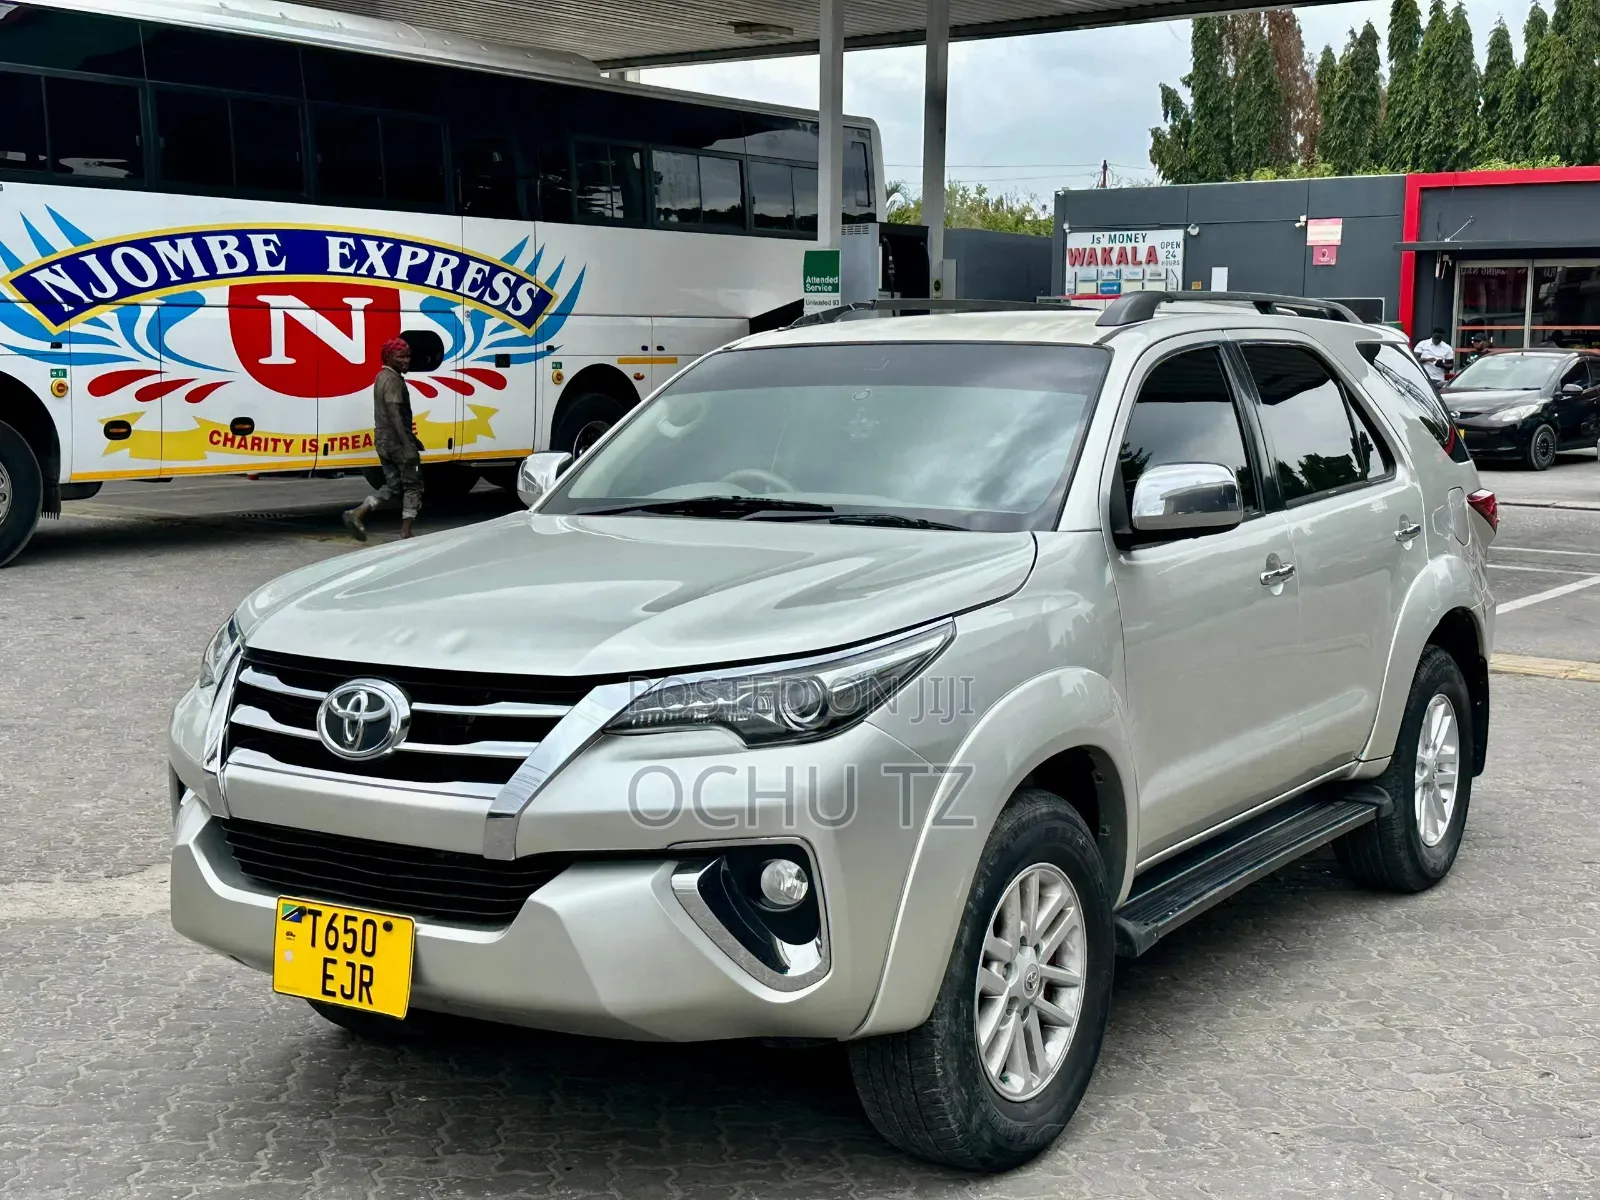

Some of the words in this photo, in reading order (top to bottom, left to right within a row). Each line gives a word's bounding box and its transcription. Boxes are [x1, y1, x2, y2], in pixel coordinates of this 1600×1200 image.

[1108, 233, 1147, 244] MONEY
[1160, 241, 1181, 249] OPEN
[1067, 246, 1158, 267] WAKALA
[1165, 250, 1177, 259] 24
[30, 234, 287, 313] NJOMBE
[326, 236, 541, 317] EXPRESS
[806, 283, 832, 291] Service
[256, 295, 374, 364] N
[208, 429, 295, 454] CHARITY
[302, 438, 320, 454] IS
[307, 908, 378, 958] T650
[321, 956, 374, 1006] EJR
